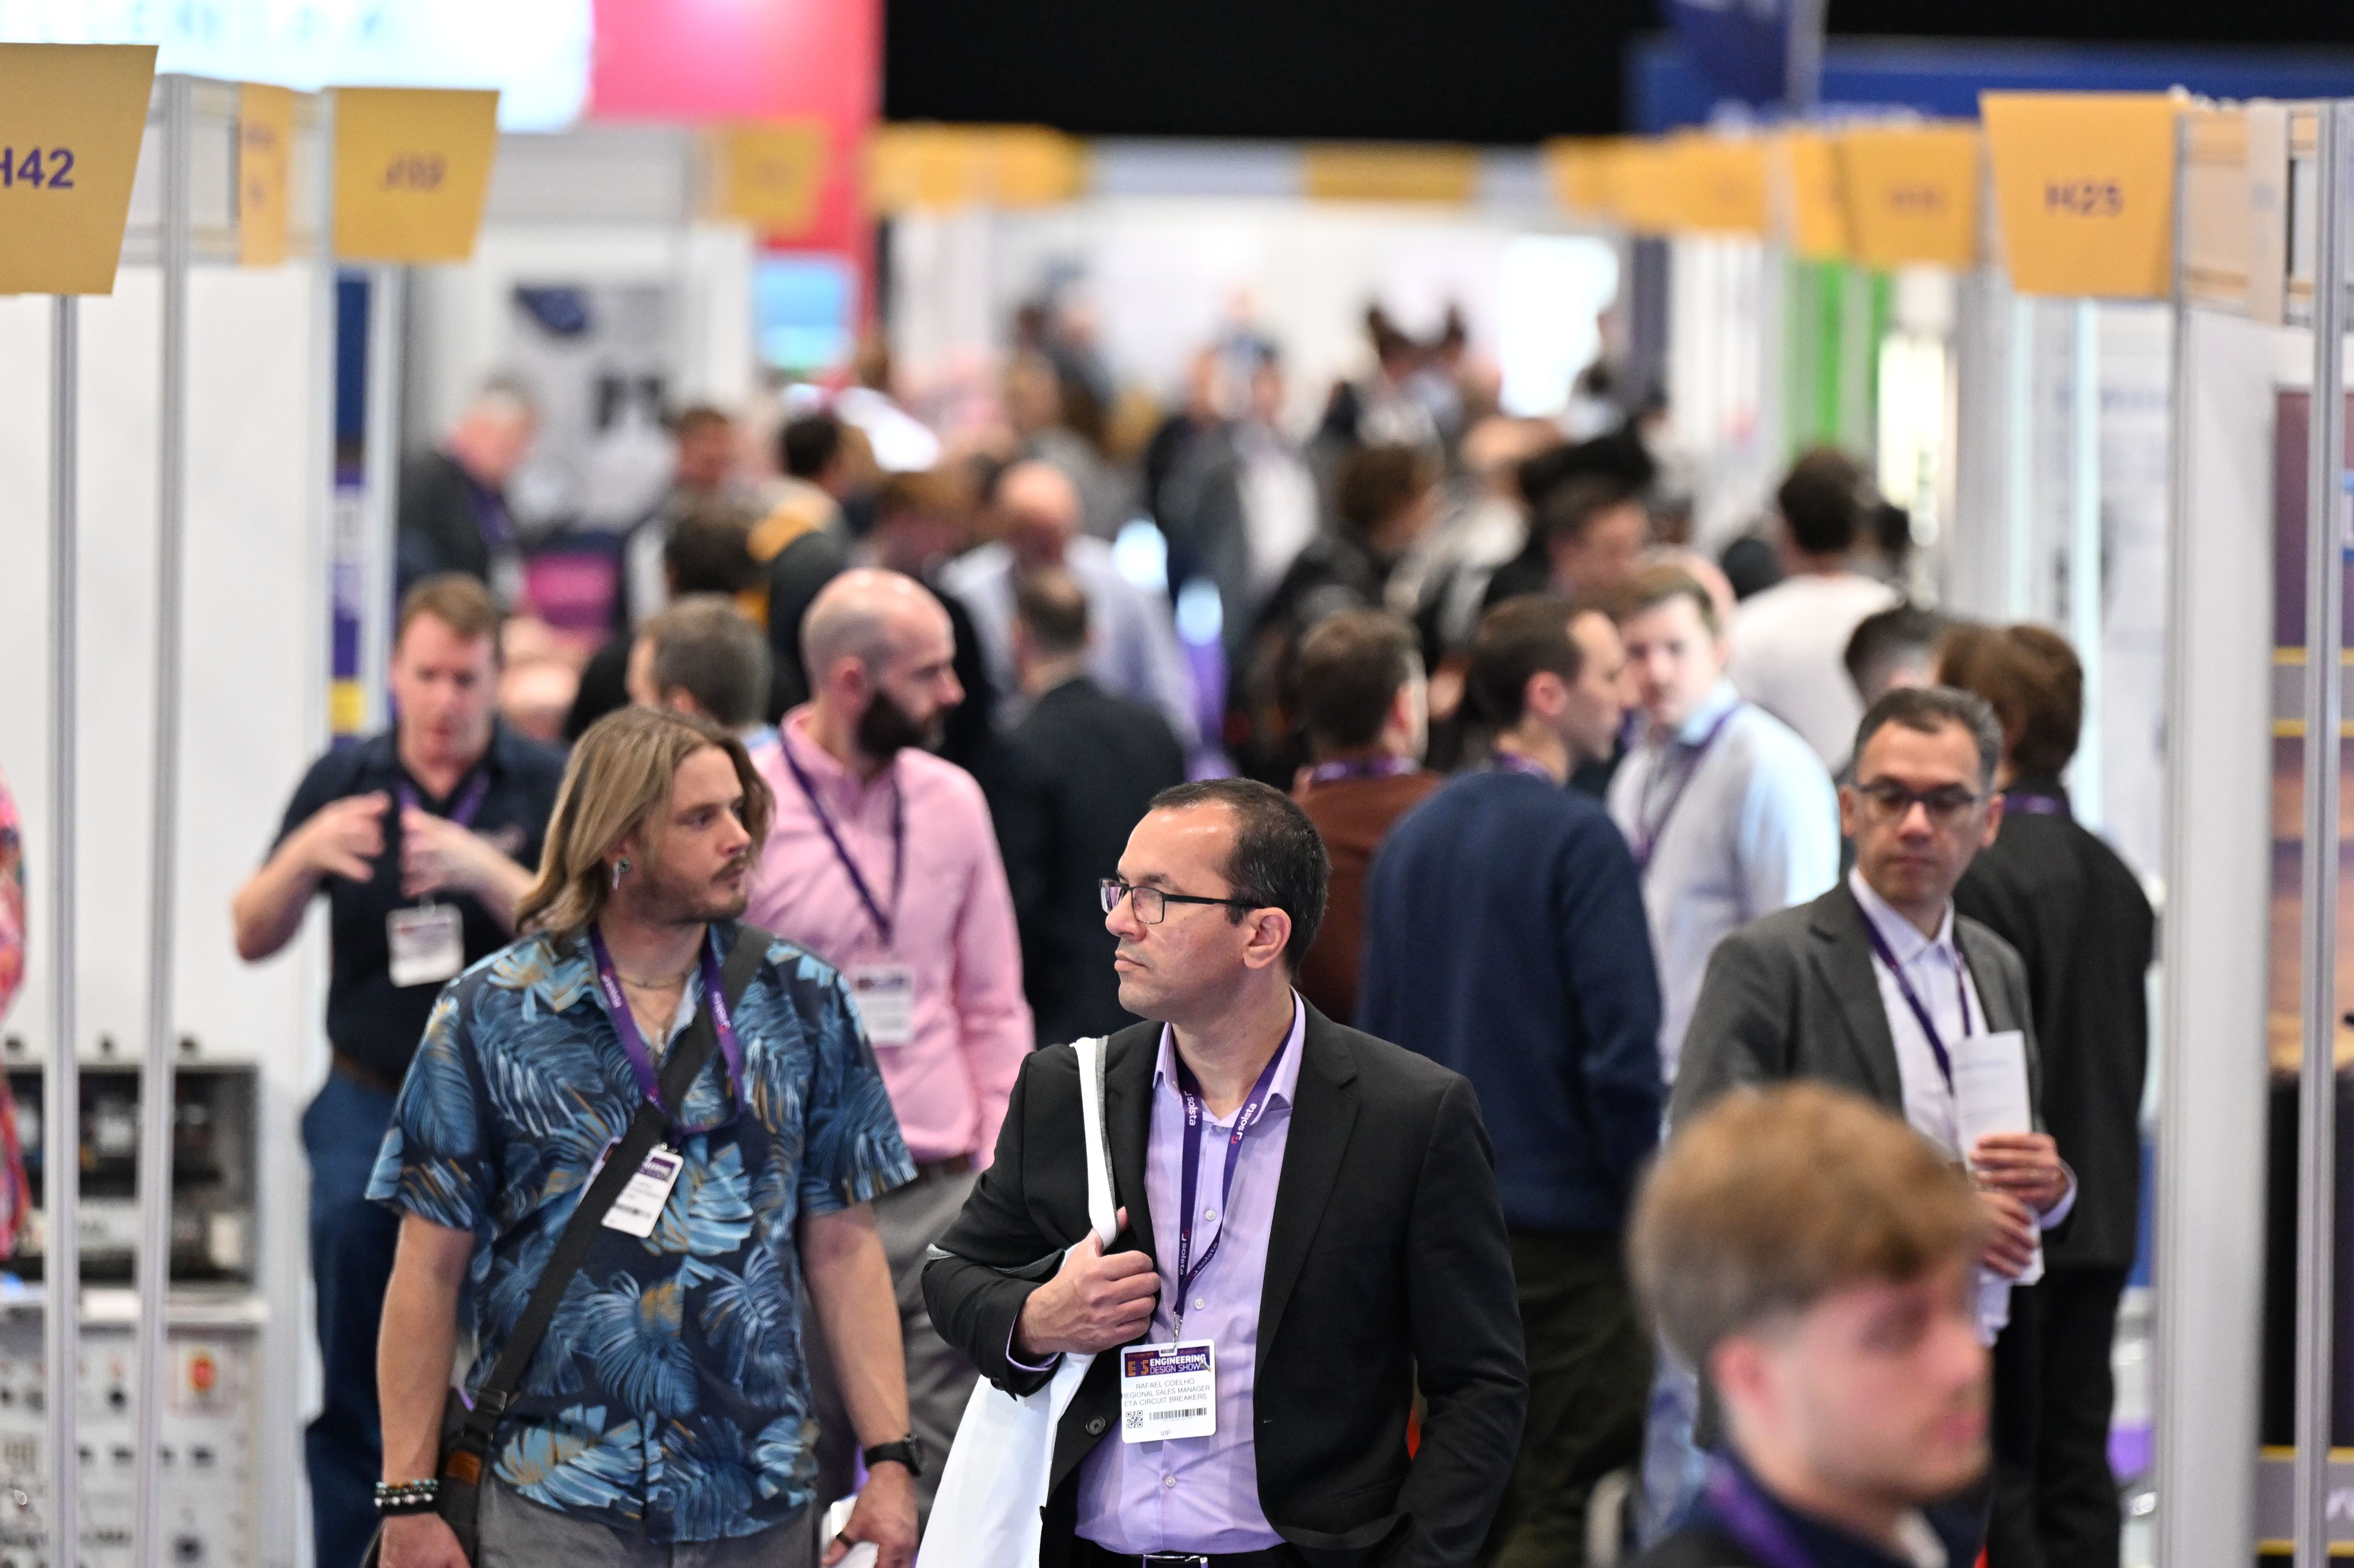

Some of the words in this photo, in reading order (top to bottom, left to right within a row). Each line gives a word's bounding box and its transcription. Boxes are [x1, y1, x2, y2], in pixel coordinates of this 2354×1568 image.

[1187, 1096, 1198, 1126] solsta
[1238, 1104, 1257, 1131] solsta
[1150, 1354, 1206, 1367] ENGINEERING
[1150, 1365, 1177, 1375] DESIGN
[1178, 1362, 1200, 1372] SHOW
[1164, 1378, 1194, 1386] COELHO
[1122, 1391, 1153, 1399] REGIONAL
[1178, 1385, 1210, 1393] MANAGER
[1170, 1393, 1207, 1403] BREAKERS
